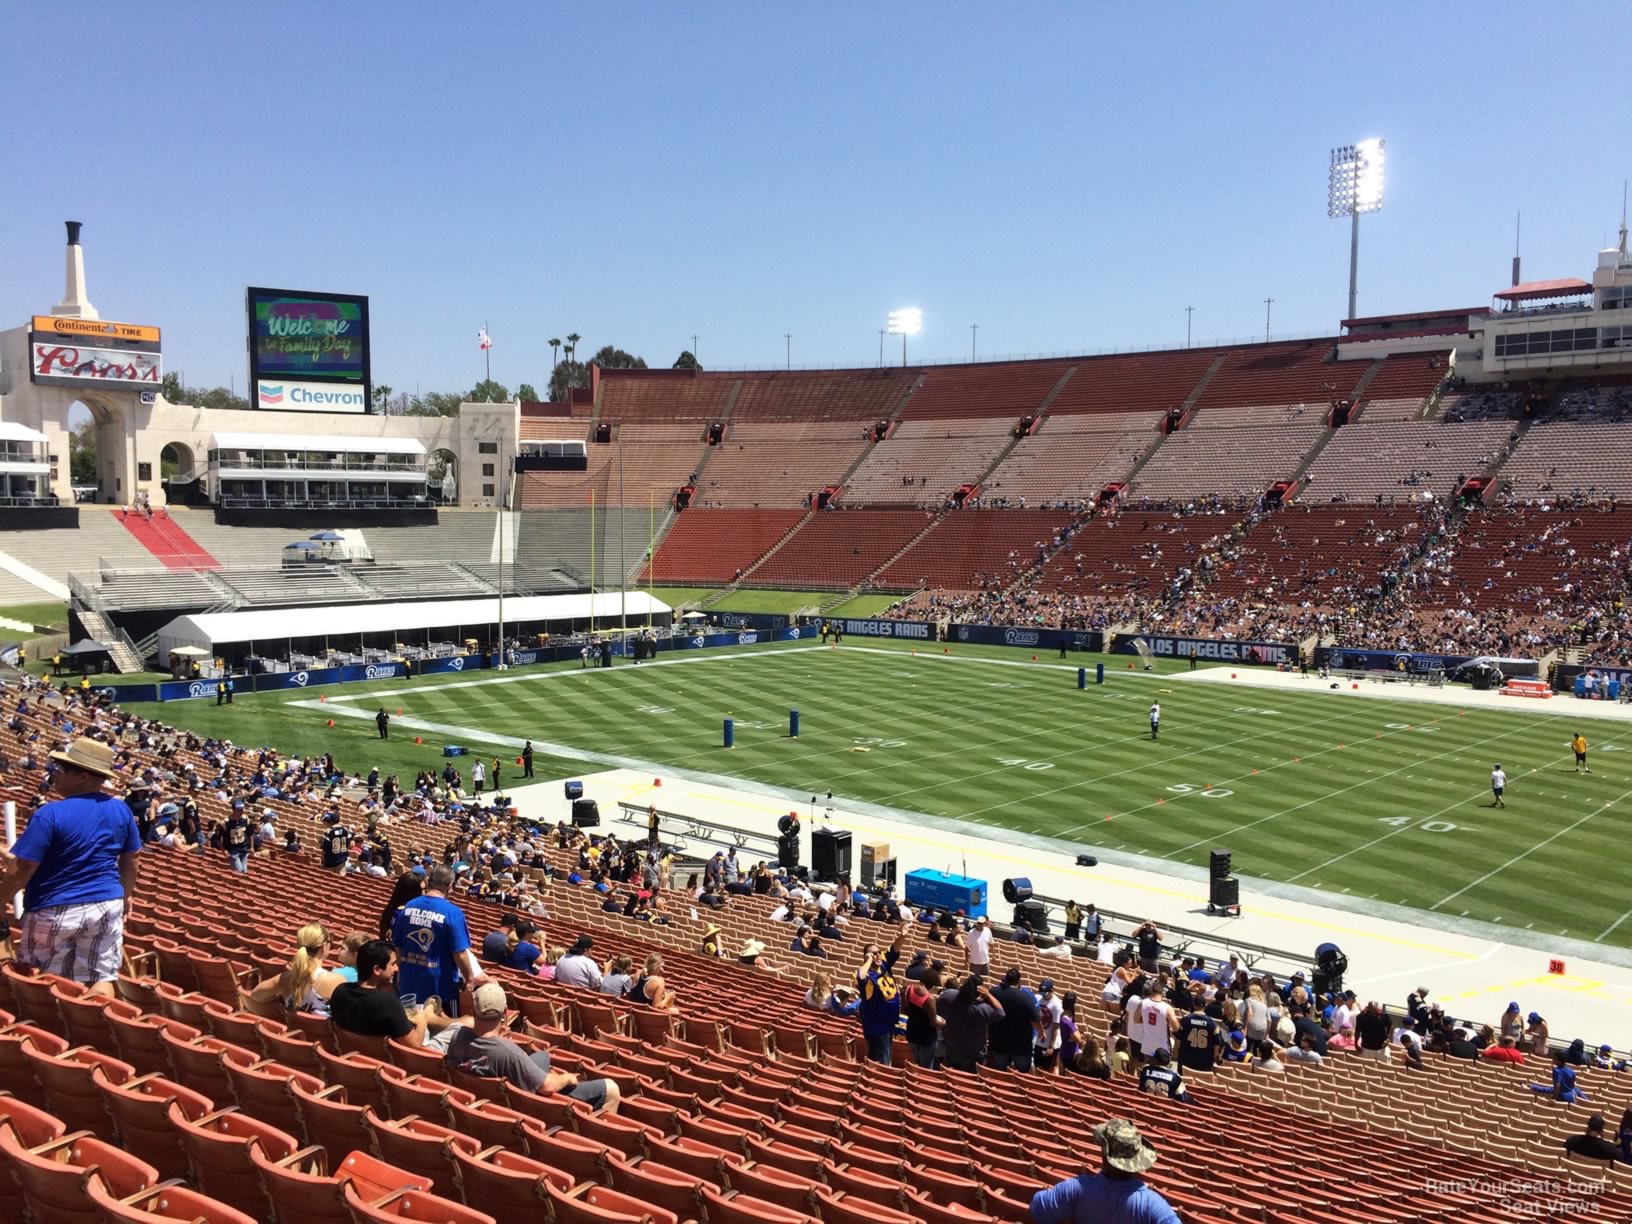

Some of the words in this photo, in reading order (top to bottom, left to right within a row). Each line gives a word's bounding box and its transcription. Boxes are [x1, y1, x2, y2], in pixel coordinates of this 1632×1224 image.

[121, 327, 142, 336] TIRE
[278, 336, 319, 361] Family
[323, 335, 352, 359] Day
[290, 387, 364, 405] Chevron
[847, 620, 892, 635] ANGELES
[895, 623, 928, 637] RAMS
[1150, 638, 1174, 654] LOS
[1177, 641, 1238, 659] ANGELES
[366, 664, 395, 679] Rams
[997, 758, 1055, 770] 40
[1166, 783, 1234, 798] 50
[1377, 816, 1457, 832] 40
[404, 907, 446, 924] WELCOME
[409, 916, 432, 928] HOME
[1550, 961, 1563, 973] 30
[1187, 1028, 1208, 1049] 46
